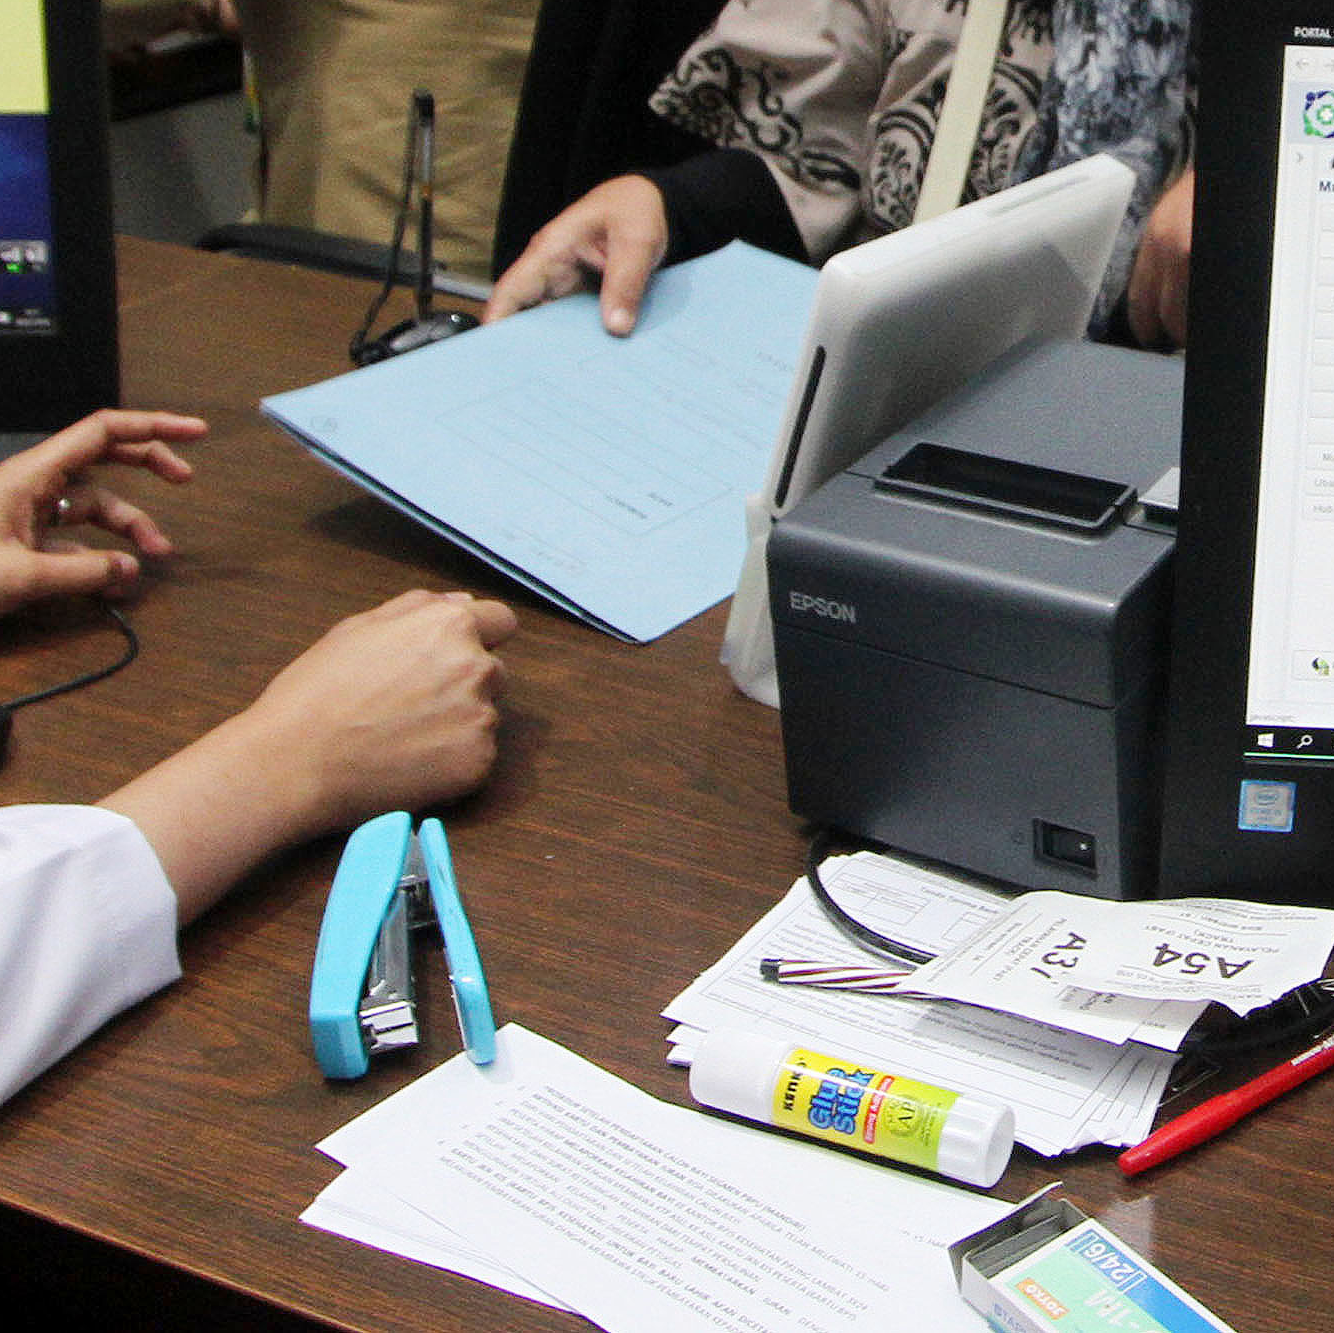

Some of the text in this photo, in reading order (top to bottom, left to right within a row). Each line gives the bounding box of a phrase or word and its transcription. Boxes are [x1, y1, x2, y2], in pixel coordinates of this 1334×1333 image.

[1294, 27, 1332, 40] PORTAL
[789, 591, 857, 623] EPSON
[1152, 942, 1255, 979] A54
[1215, 941, 1280, 954] PELAYANAN
[808, 1067, 847, 1130] Glue
[833, 1069, 875, 1135] Stick
[1084, 1239, 1135, 1285] 24/6
[1024, 1282, 1069, 1317] JOYKO
